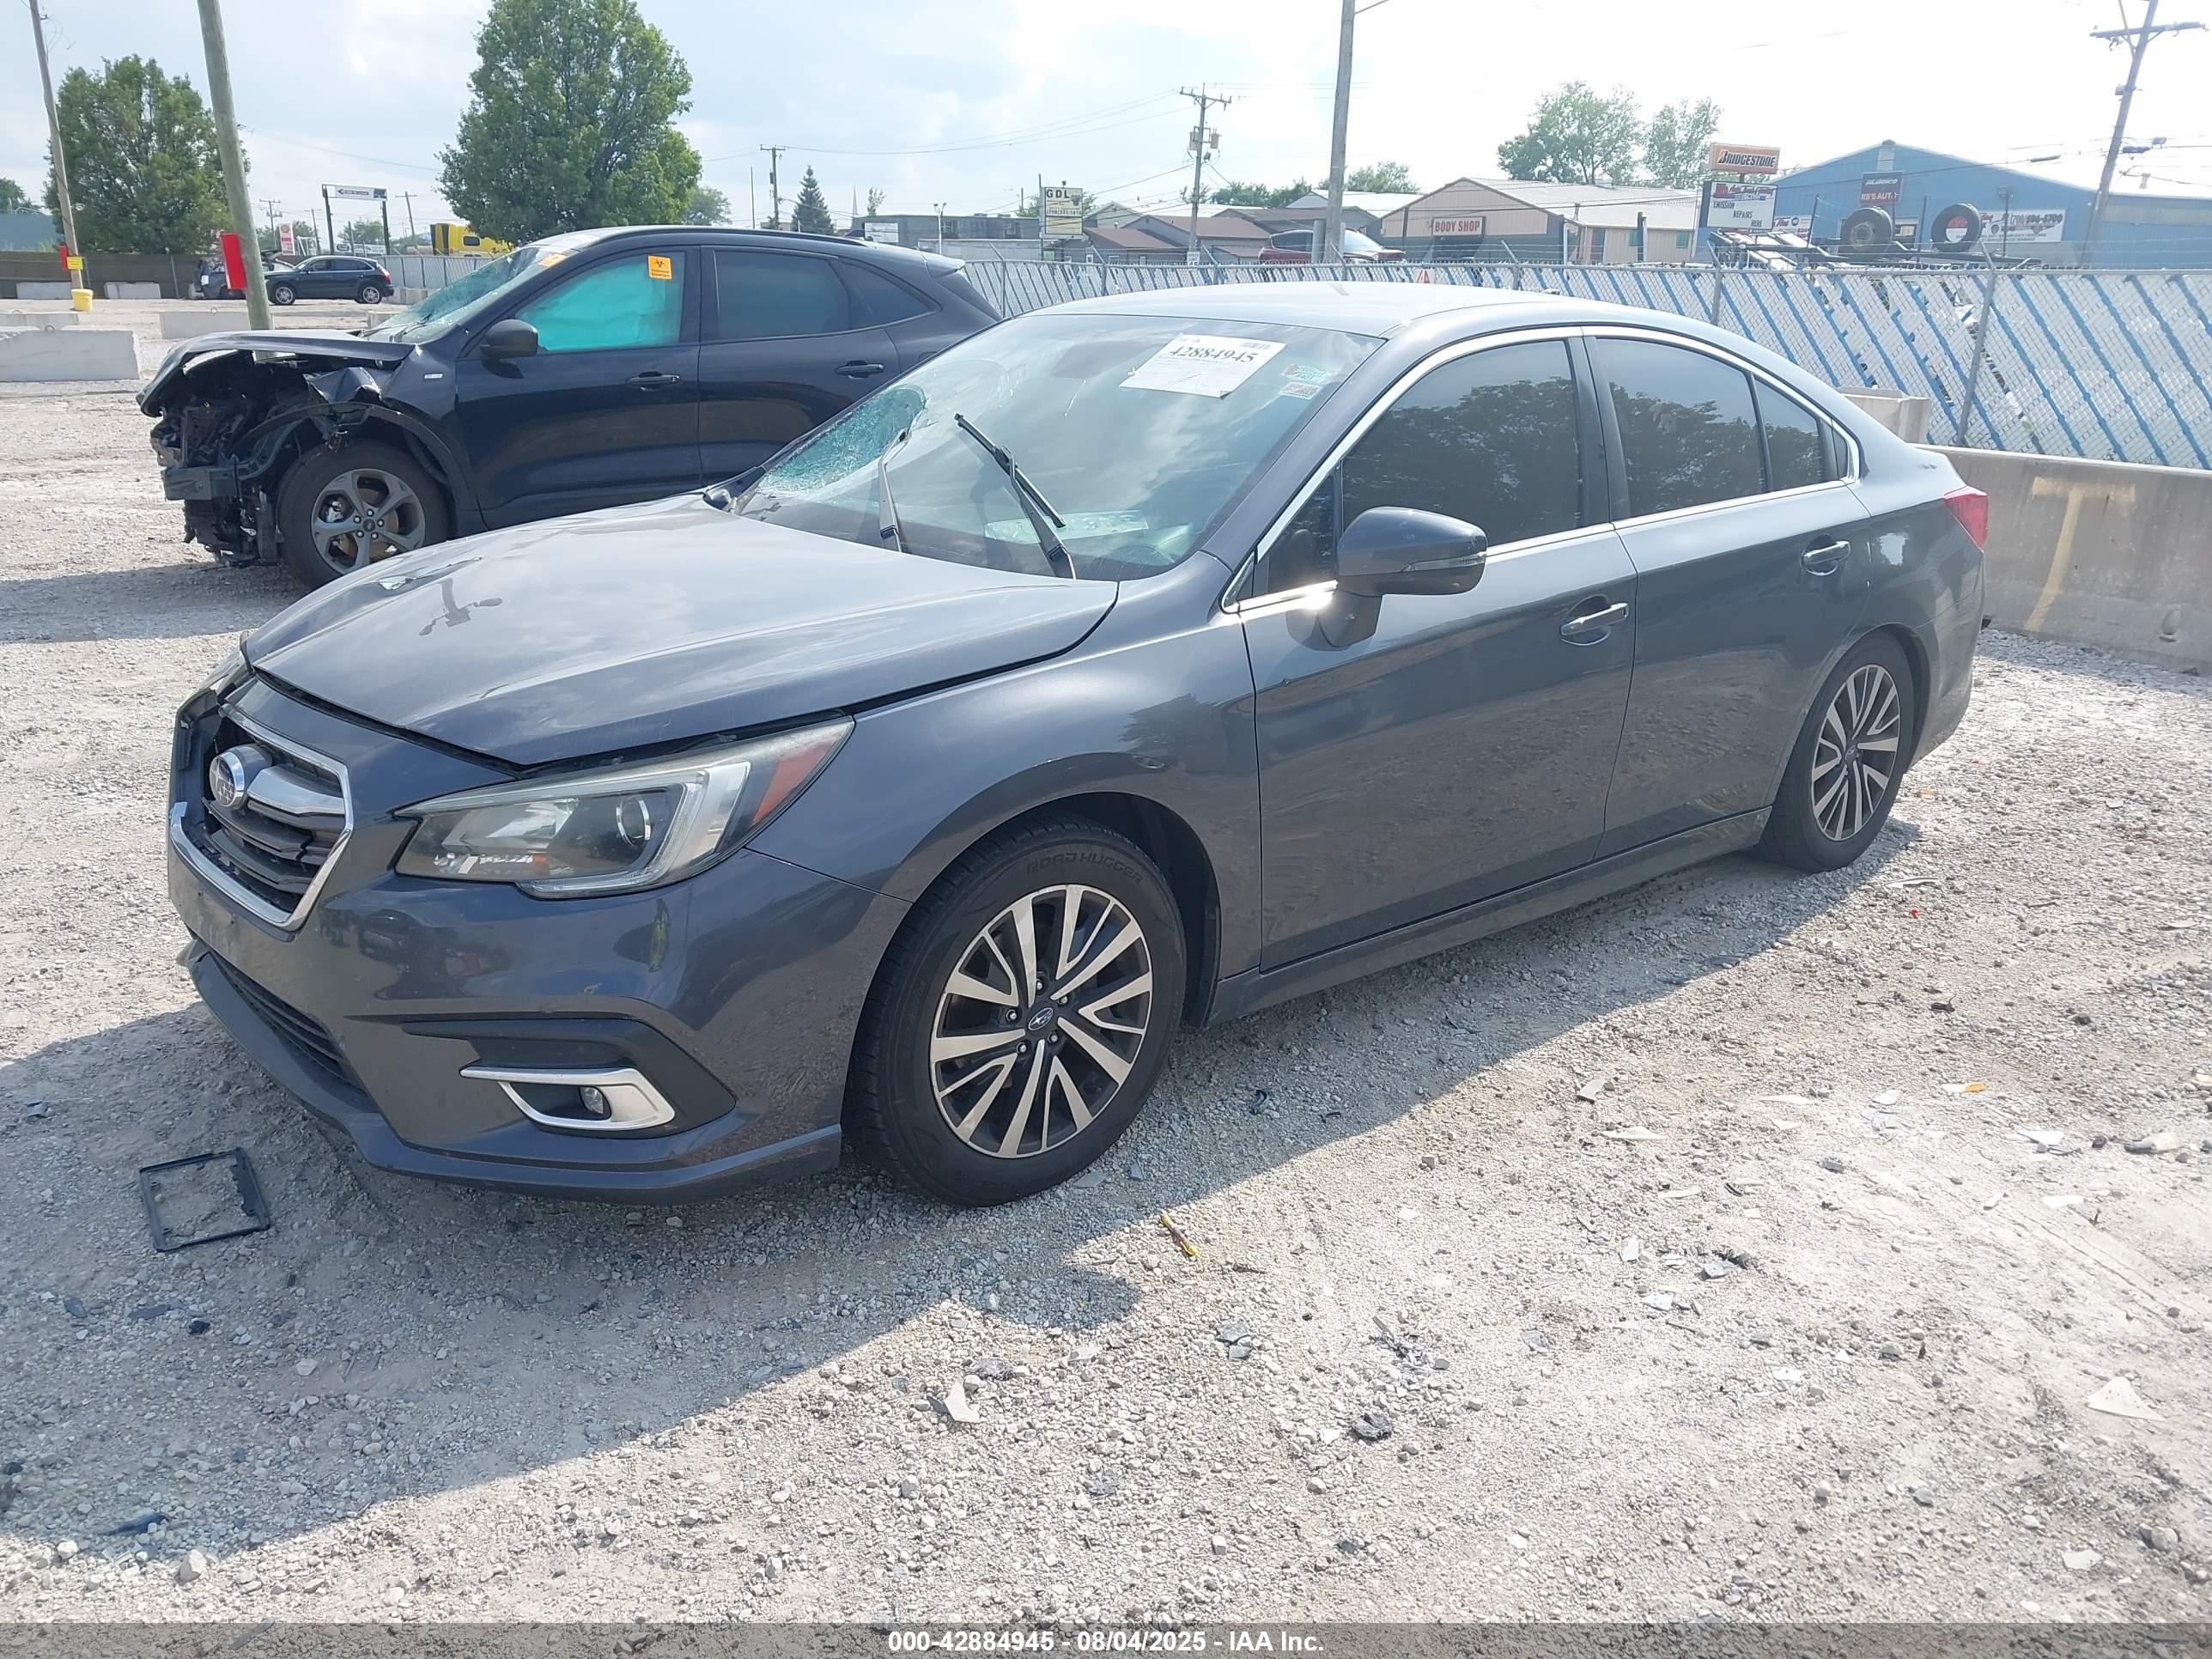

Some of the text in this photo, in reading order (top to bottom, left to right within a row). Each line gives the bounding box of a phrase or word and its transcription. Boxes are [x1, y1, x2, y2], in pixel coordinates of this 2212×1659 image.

[1717, 150, 1778, 167] BRIDGESTONE
[1733, 210, 1753, 219] REPAIRS
[1435, 220, 1480, 232] BODY SHOP
[1169, 346, 1259, 363] 42884945
